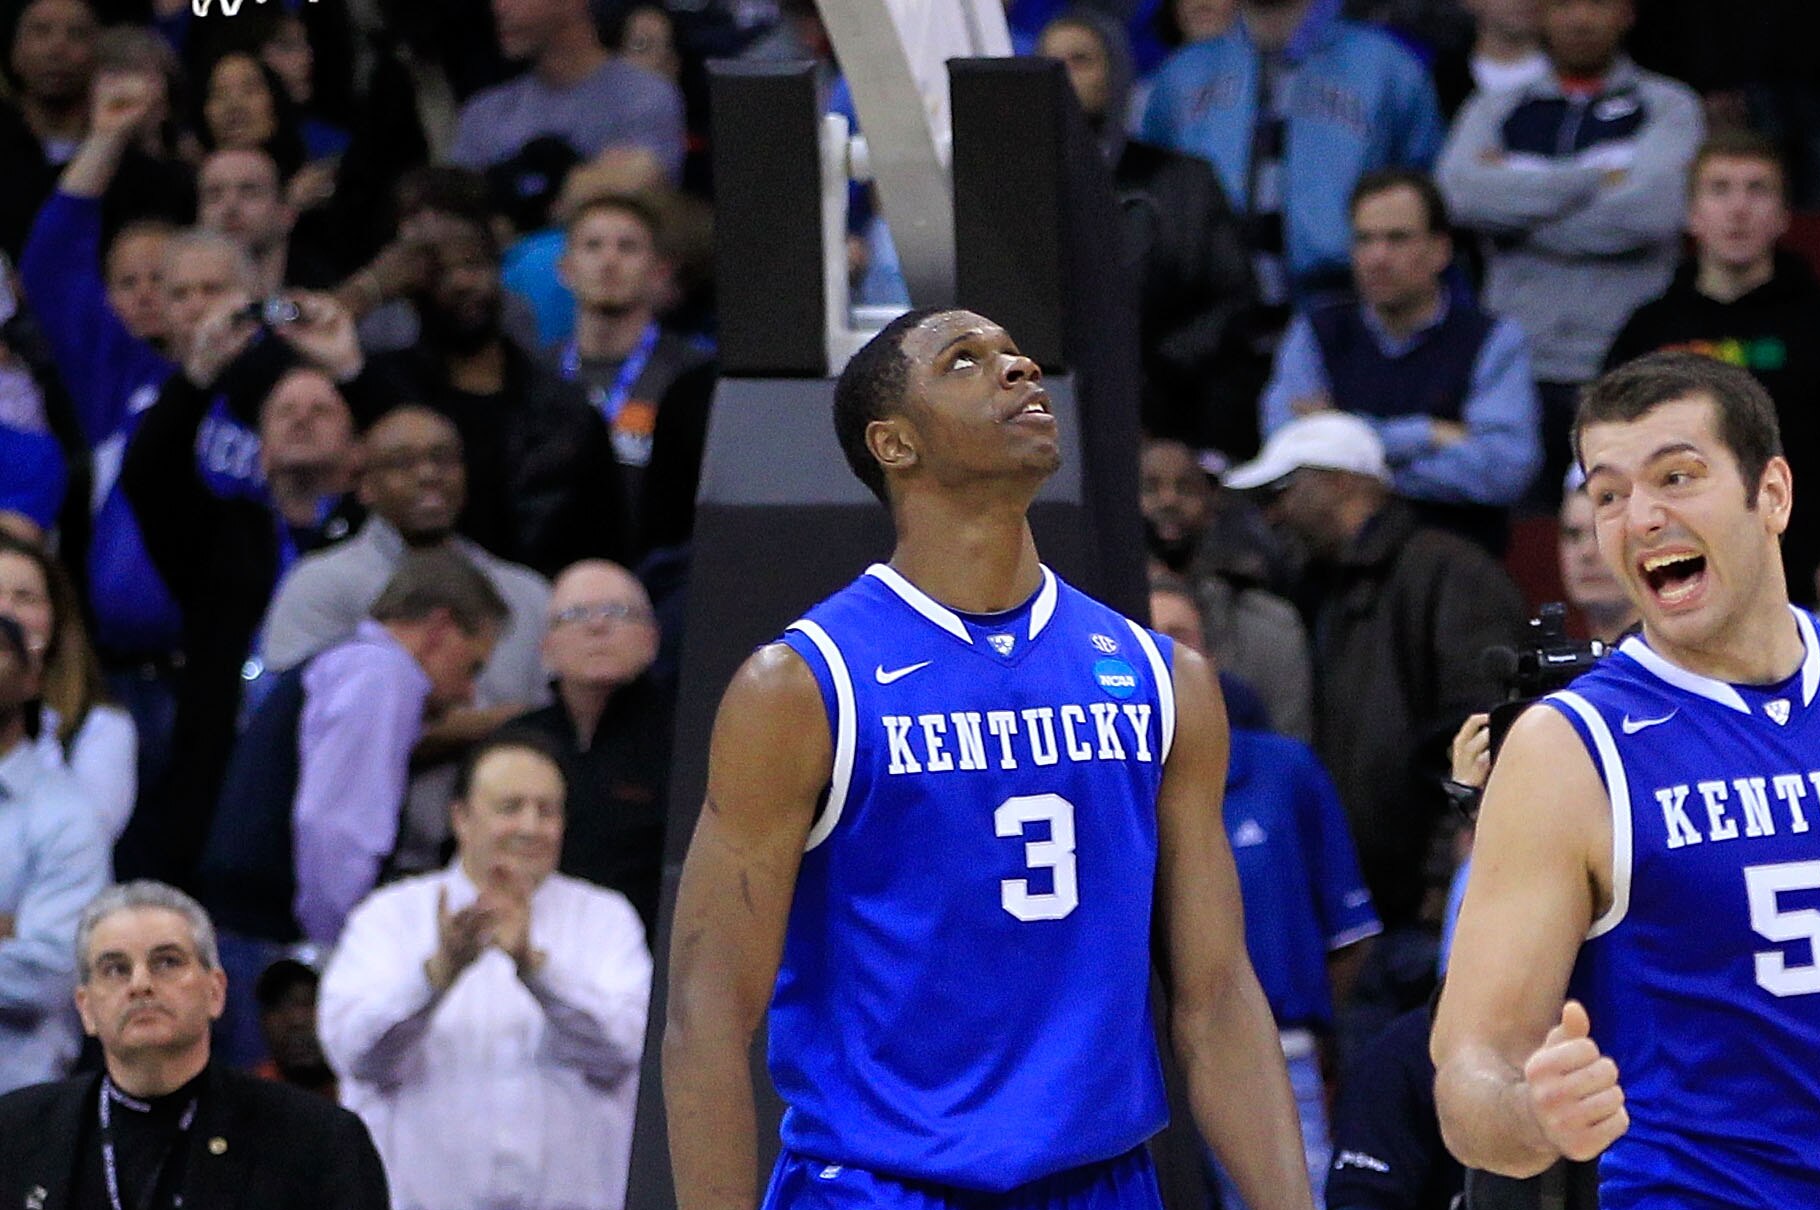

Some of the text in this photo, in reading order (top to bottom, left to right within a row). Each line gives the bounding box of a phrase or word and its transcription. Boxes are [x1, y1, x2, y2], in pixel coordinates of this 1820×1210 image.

[1098, 674, 1136, 687] NCAA
[881, 702, 1152, 775] KENTUCKY
[994, 793, 1079, 922] 3
